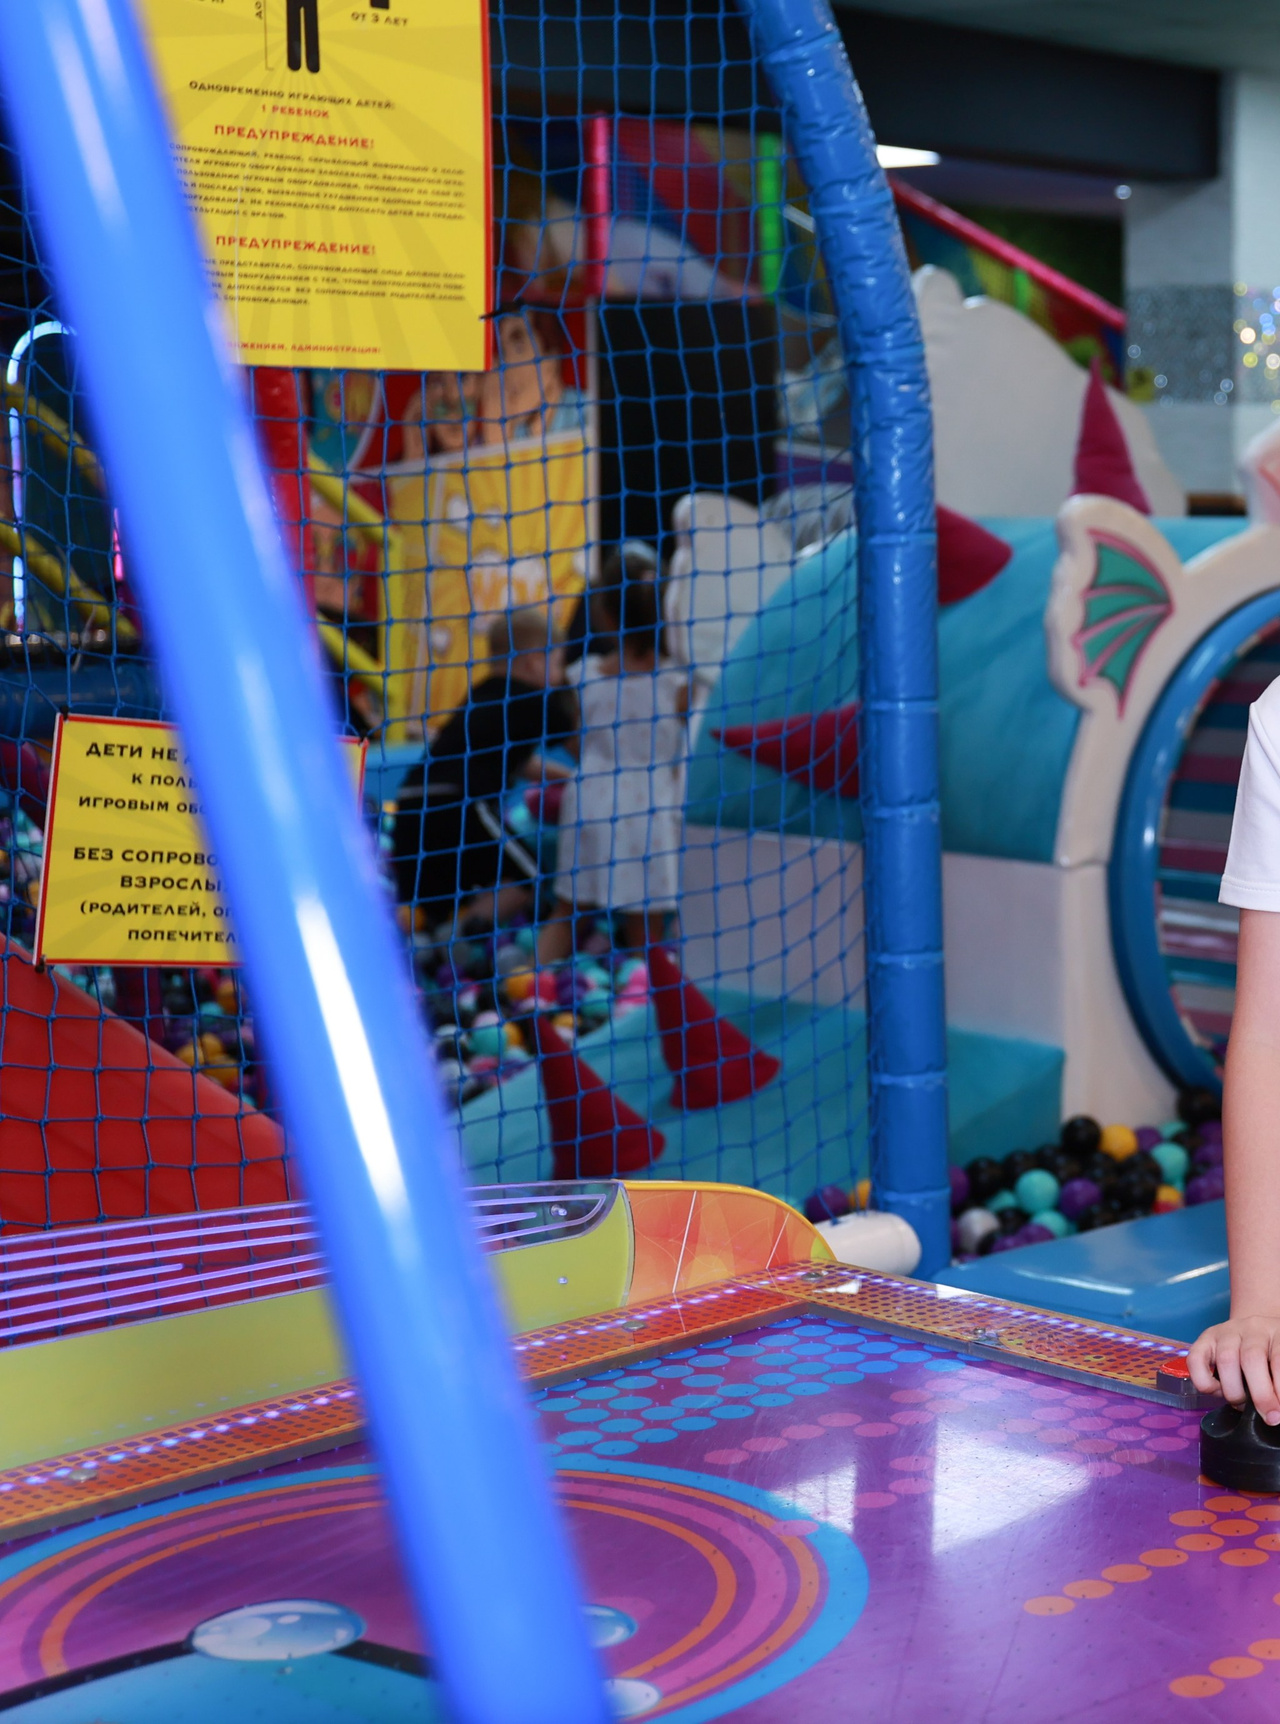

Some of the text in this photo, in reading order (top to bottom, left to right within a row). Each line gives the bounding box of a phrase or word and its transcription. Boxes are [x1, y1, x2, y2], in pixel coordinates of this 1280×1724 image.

[351, 12, 408, 26] ОТ 3 ЛЕТ
[189, 80, 284, 98] ОДНОВРЕМЕННО
[288, 91, 352, 106] ИГРАЮЩИХ
[262, 104, 329, 118] 1 РЕБЕНОК
[214, 124, 374, 148] ПРЕДУПРЕЖДЕНИЕ!
[216, 236, 376, 256] ПРЕДУПРЕЖДЕНИЕ!
[86, 742, 143, 758] ДЕТИ
[151, 746, 178, 762] НЕ
[132, 773, 143, 784] К
[78, 795, 169, 812] ИГРОВЫМ
[74, 847, 218, 866] БЕЗ СОПРОВО
[120, 876, 222, 892] ВЗРОСЛЫ
[80, 899, 206, 918] (РОДИТЕЛЕЙ,
[128, 928, 237, 944] ПОПЕЧИТЕЛ
